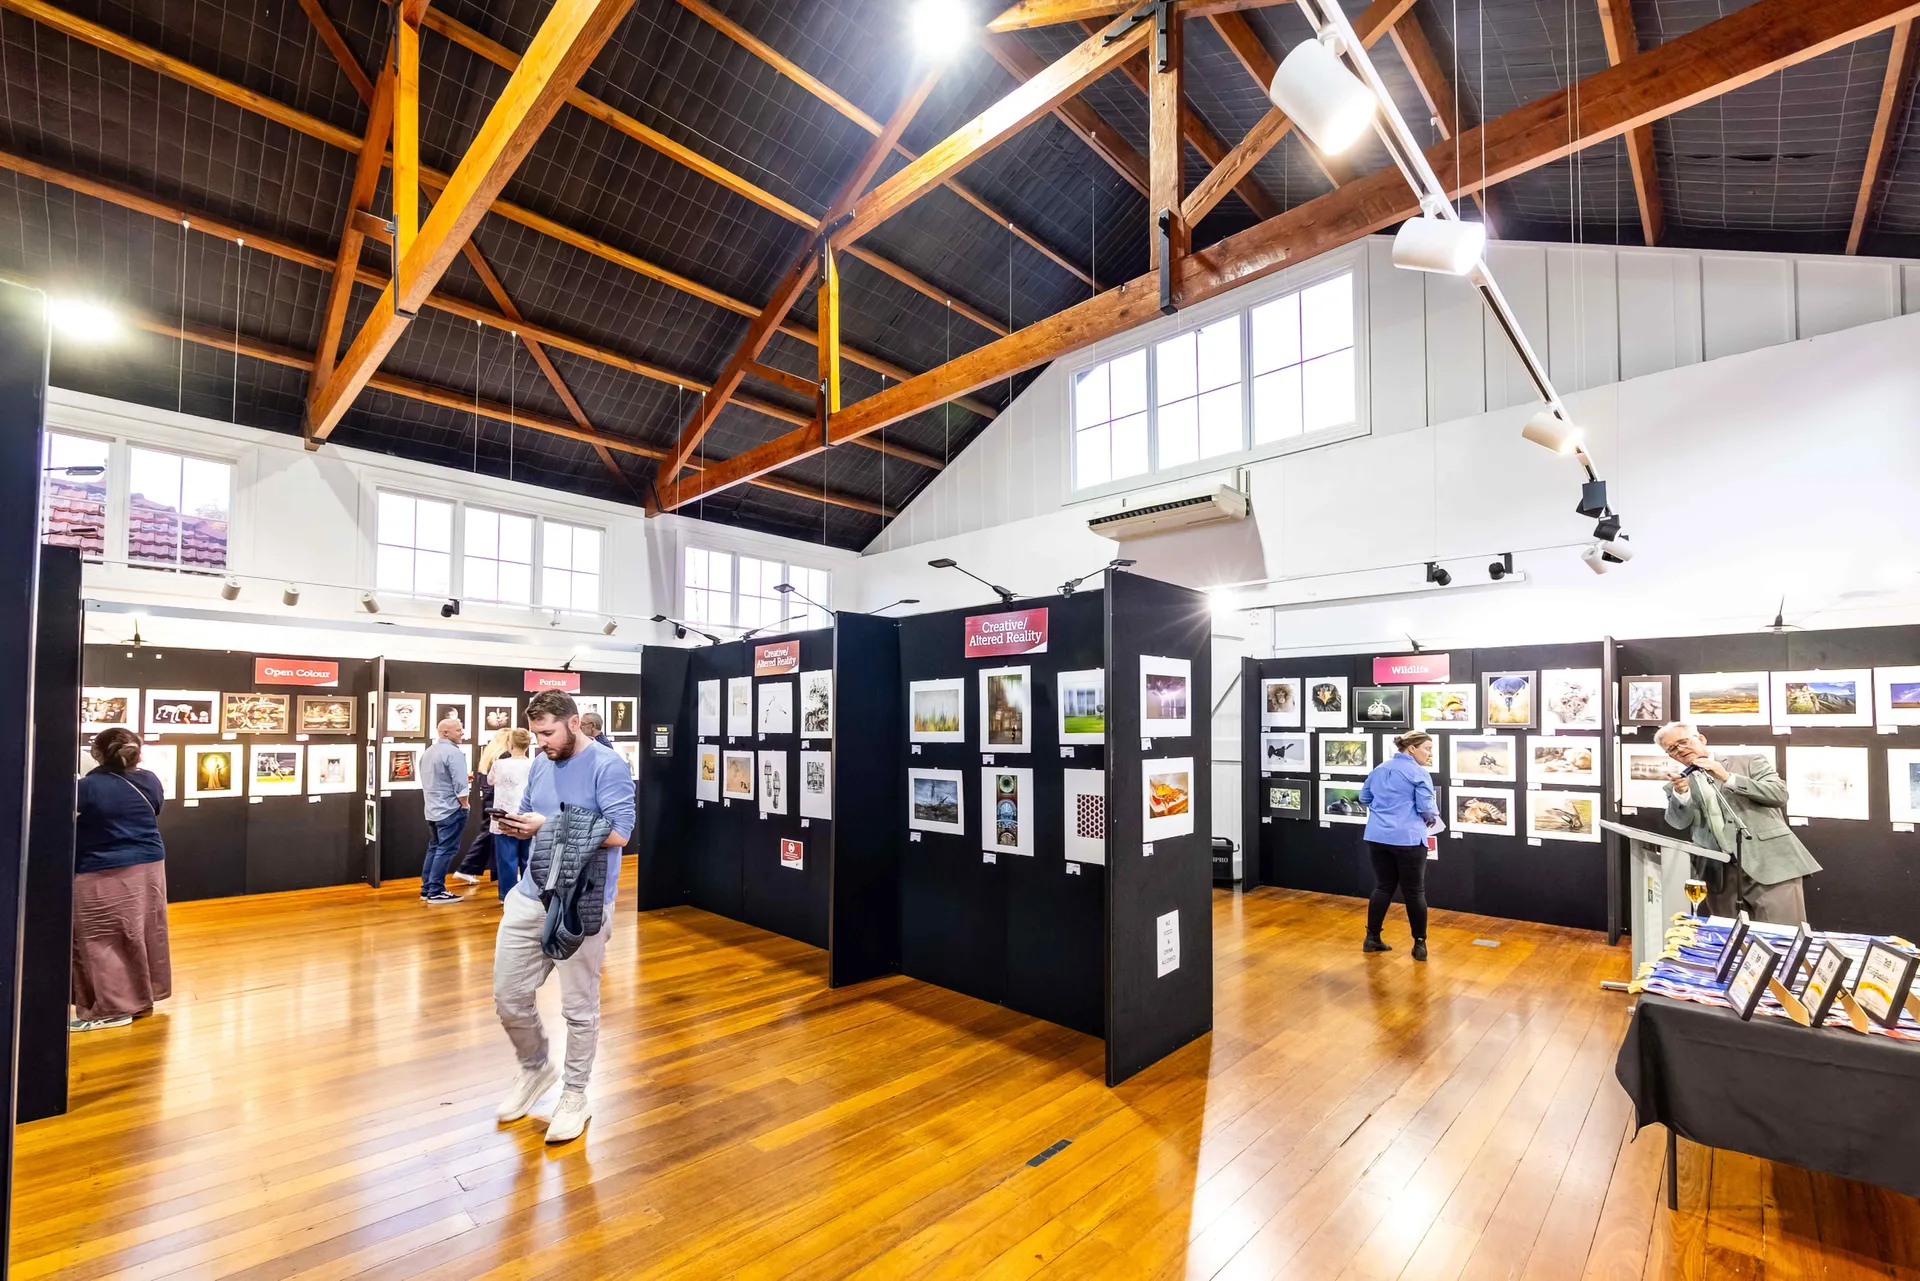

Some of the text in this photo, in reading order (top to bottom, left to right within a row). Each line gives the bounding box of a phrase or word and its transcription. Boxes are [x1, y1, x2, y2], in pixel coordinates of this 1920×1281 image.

[982, 617, 1028, 633] Creative/
[969, 630, 1042, 646] Altered Reality
[264, 667, 330, 678] Open Colour
[1391, 665, 1429, 674] Wildlife
